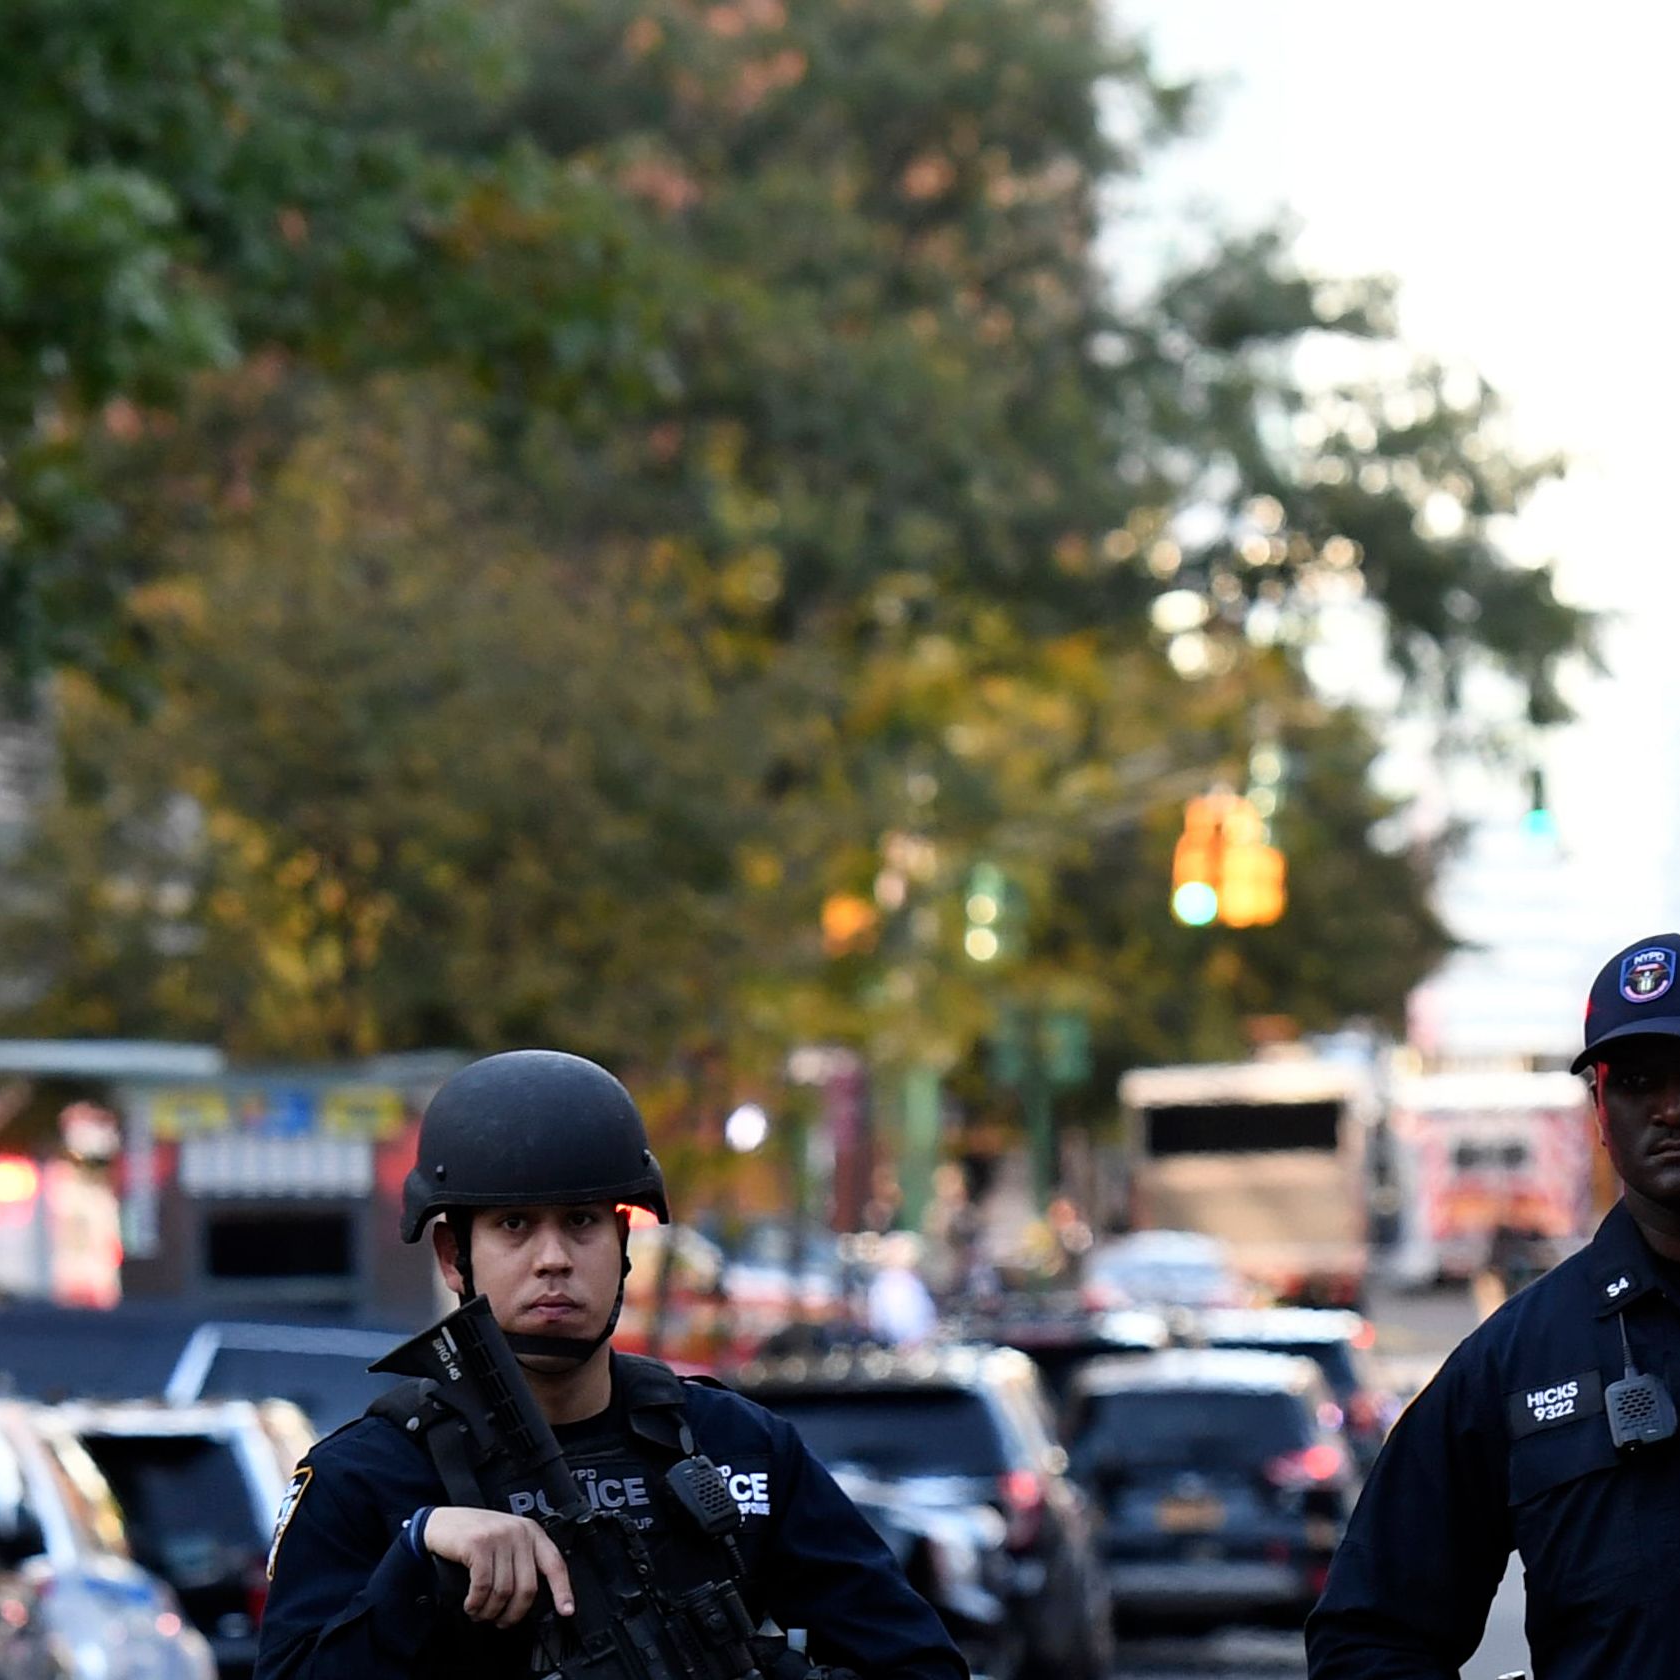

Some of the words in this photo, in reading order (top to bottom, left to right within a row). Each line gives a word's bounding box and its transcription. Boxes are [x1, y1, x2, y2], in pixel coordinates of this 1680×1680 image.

[1634, 951, 1665, 965] NYPD
[1606, 1277, 1630, 1298] S4
[1526, 1381, 1579, 1408] HICKS
[1533, 1399, 1575, 1422] 9322
